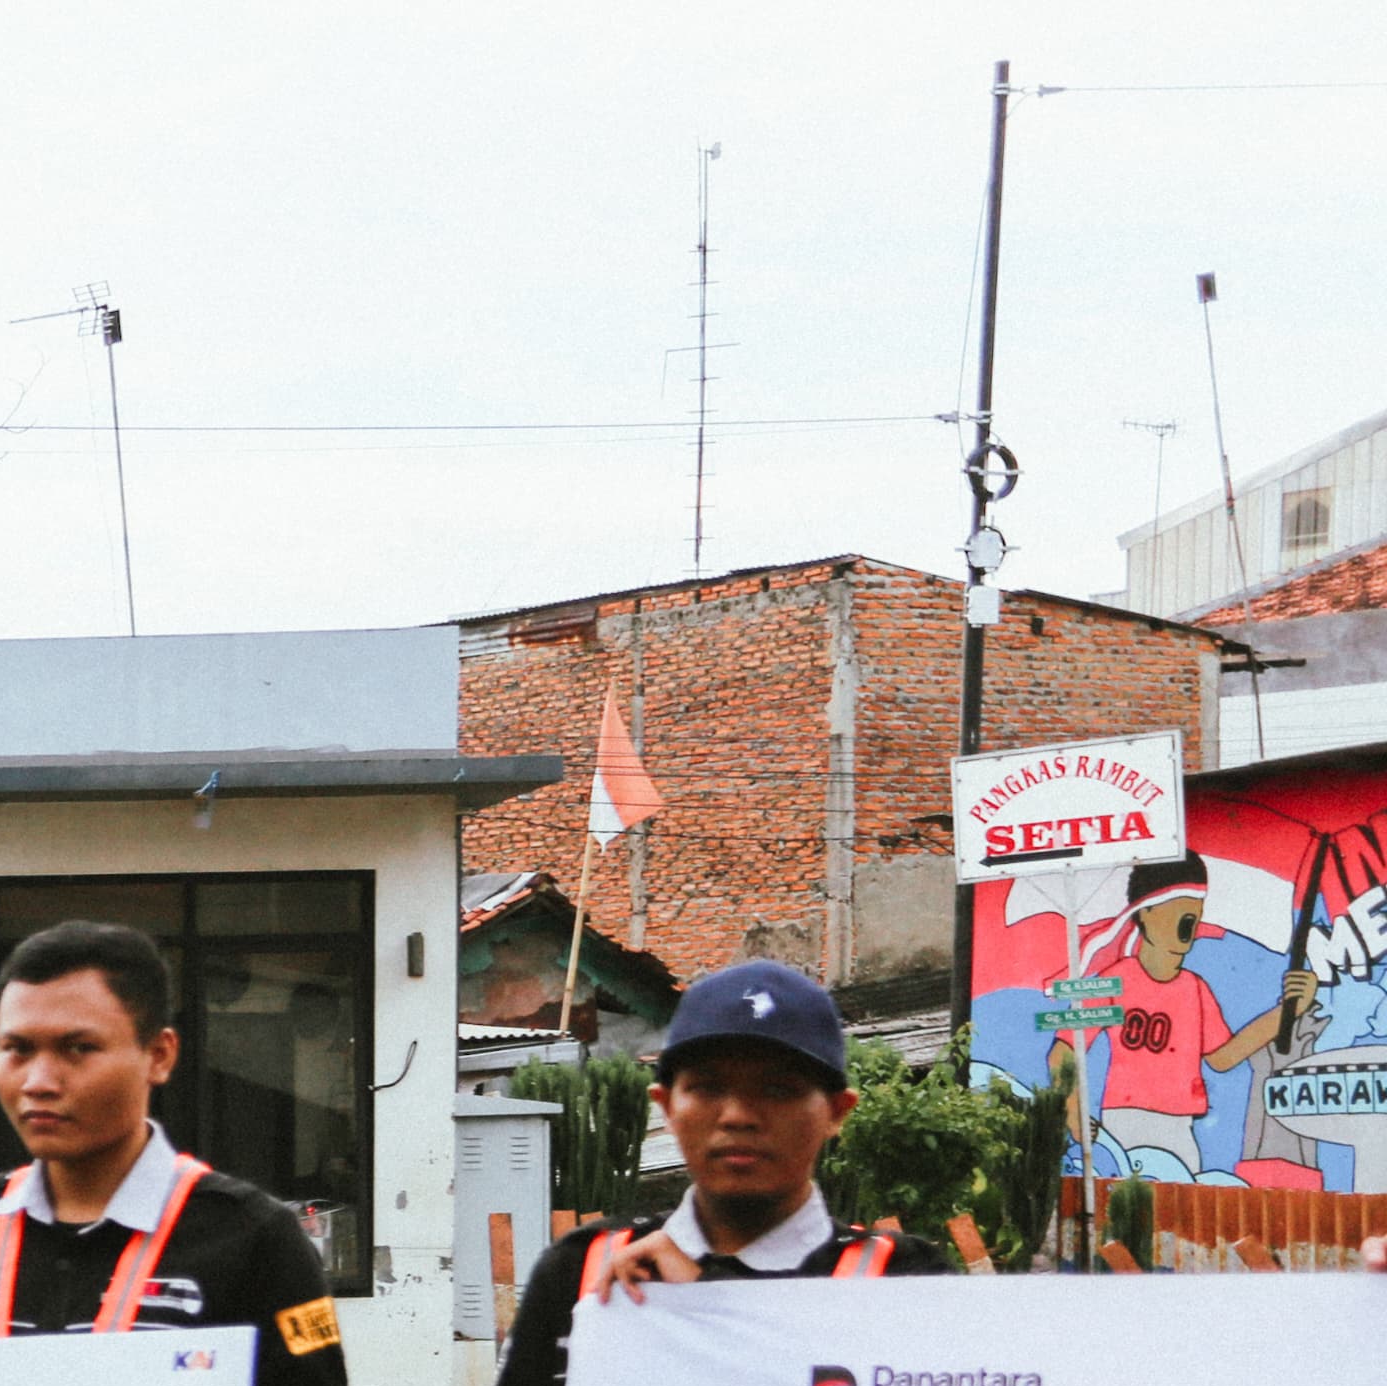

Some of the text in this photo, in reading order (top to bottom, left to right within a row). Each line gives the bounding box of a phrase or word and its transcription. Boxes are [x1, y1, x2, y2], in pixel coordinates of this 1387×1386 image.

[969, 755, 1164, 824] PANGKAS RAMBUT
[985, 811, 1155, 857] SETIA
